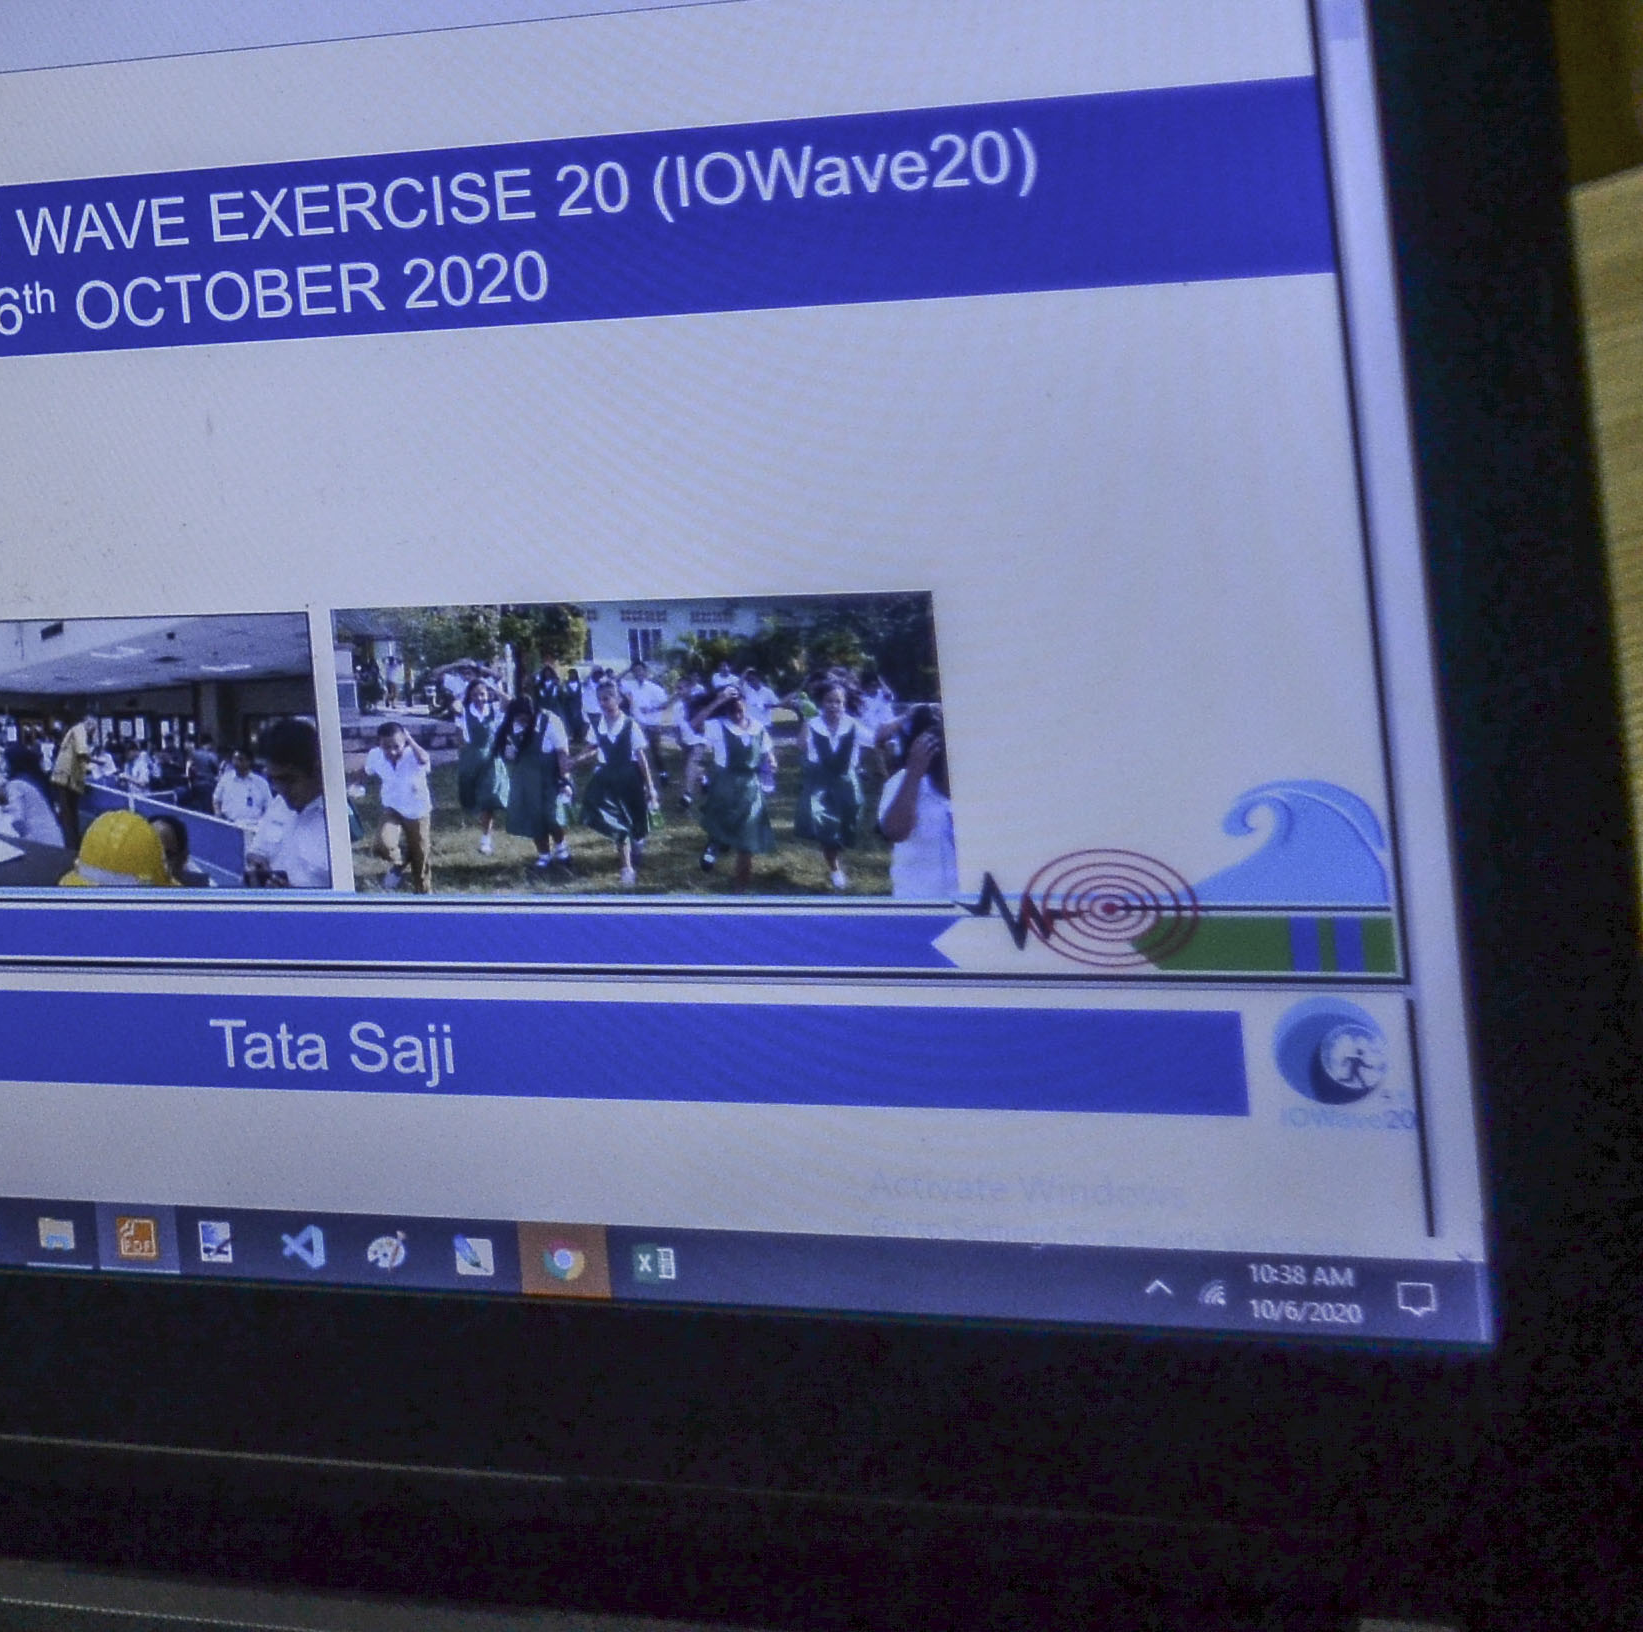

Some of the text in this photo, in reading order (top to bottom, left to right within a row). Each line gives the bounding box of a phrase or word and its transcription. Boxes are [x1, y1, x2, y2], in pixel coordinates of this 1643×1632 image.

[16, 195, 191, 258] WAVE
[209, 167, 533, 243] EXERCISE
[556, 159, 630, 218] 20
[652, 125, 1039, 225] (IOWave20)
[76, 260, 386, 331] OCTOBER
[404, 248, 549, 311] 2020
[209, 1019, 456, 1088] Tata Saji
[1249, 1263, 1355, 1287] 10:38 AM
[1249, 1298, 1364, 1324] 10/6/2020
